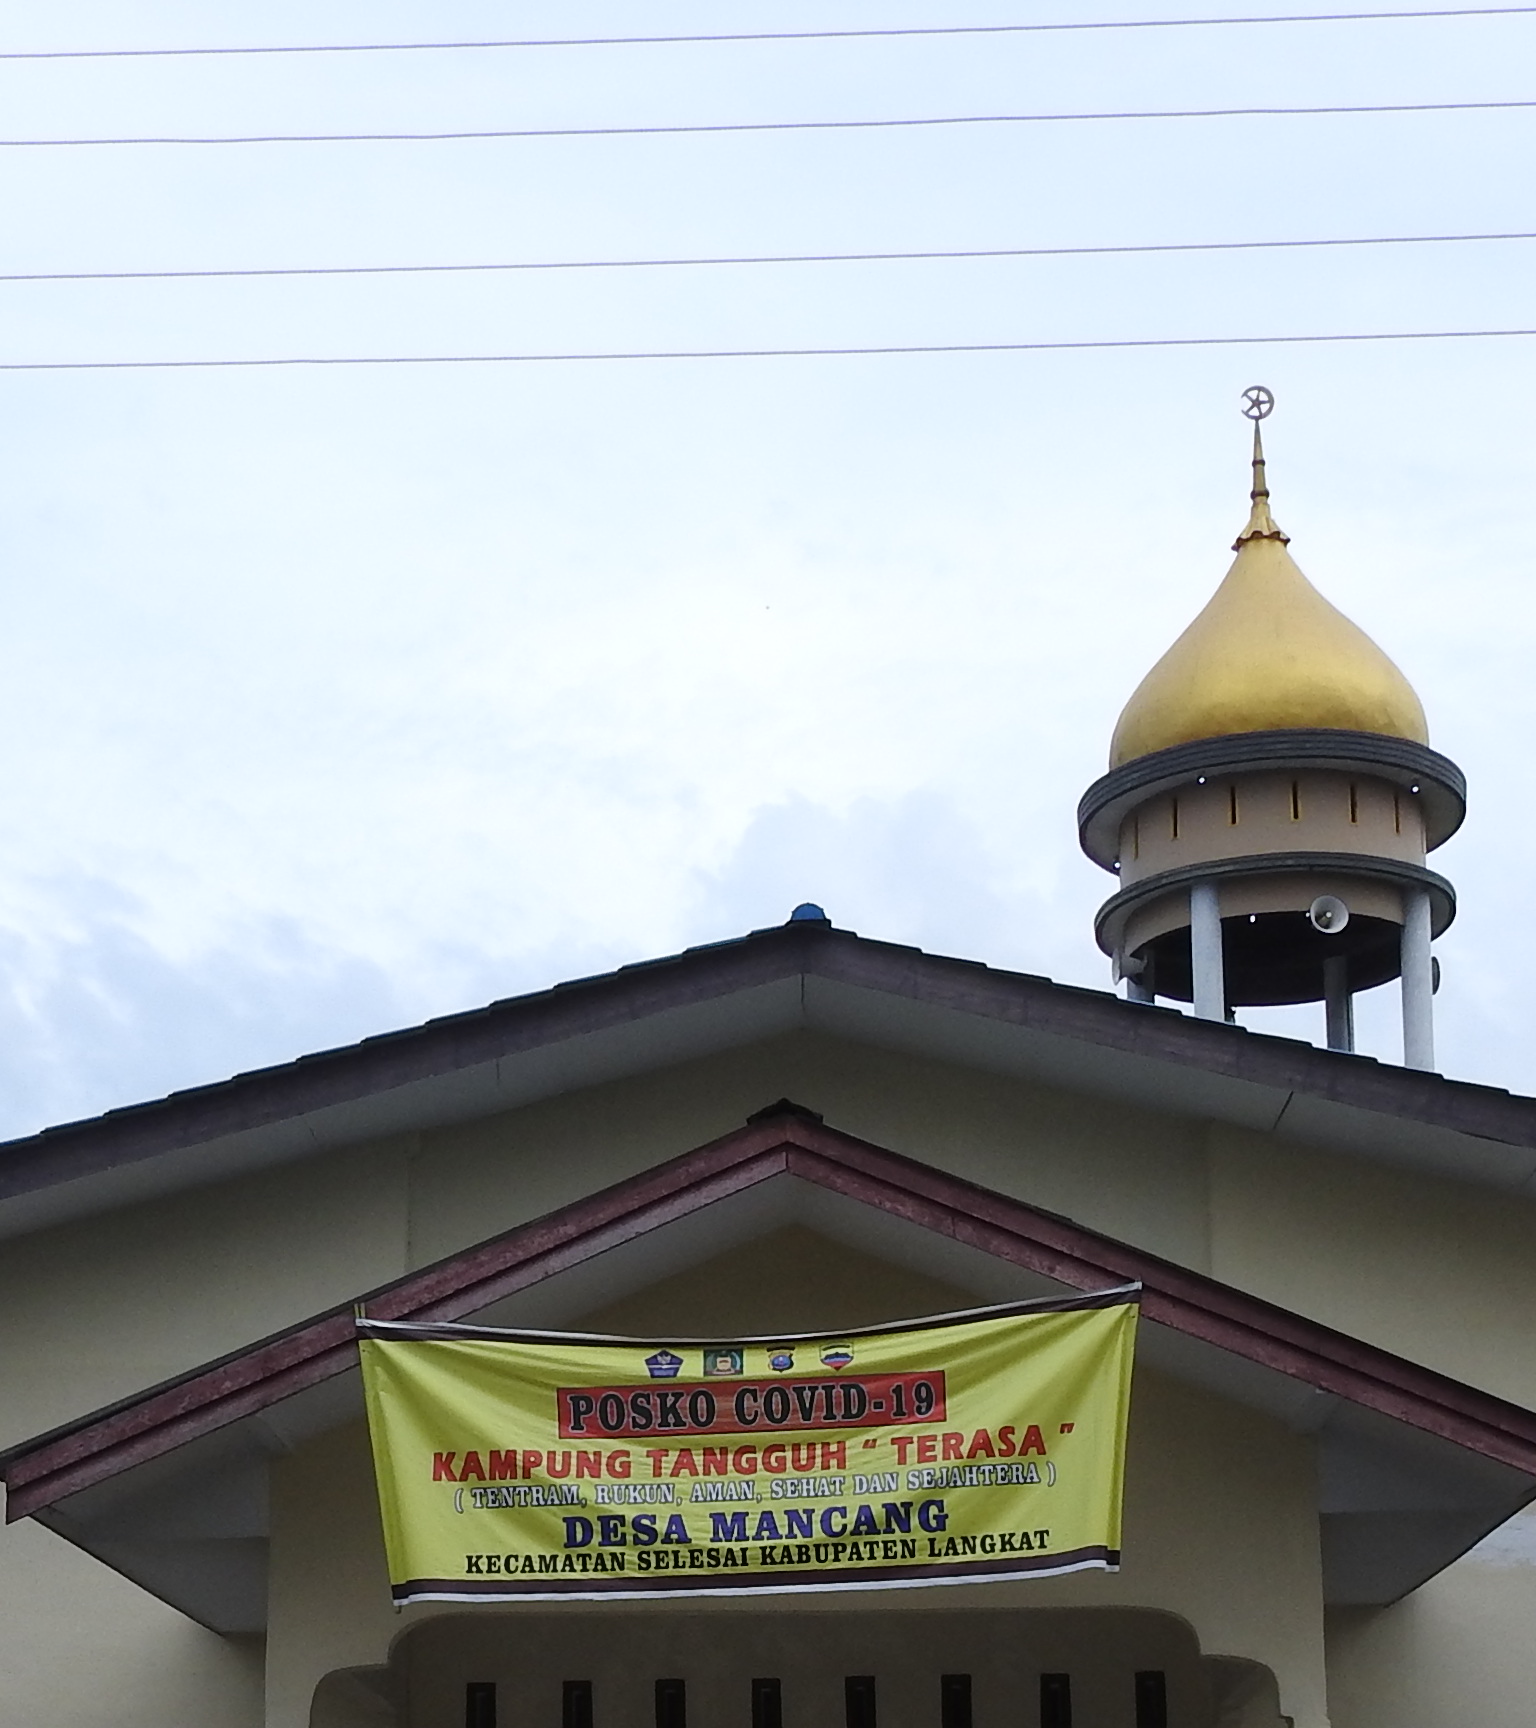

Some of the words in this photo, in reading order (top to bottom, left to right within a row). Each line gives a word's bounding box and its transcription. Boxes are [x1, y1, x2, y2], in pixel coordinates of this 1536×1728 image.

[567, 1389, 716, 1431] POSKO
[734, 1381, 935, 1427] COVID-19
[432, 1449, 632, 1482] KAMPUNG
[646, 1440, 847, 1478] TANGGUH
[890, 1424, 1048, 1466] TERASA
[471, 1484, 587, 1509] TENTRAM,
[594, 1482, 683, 1507] RUKUN,
[690, 1479, 762, 1504] AMAN,
[770, 1476, 846, 1500] SEHAT
[853, 1472, 899, 1496] DAN
[907, 1462, 1041, 1489] SEJAHTERA
[563, 1514, 692, 1549] DESA
[709, 1500, 949, 1543] MANCANG
[465, 1552, 626, 1574] KECAMATAN
[637, 1545, 750, 1571] SELESAI
[760, 1538, 917, 1567] KABUPATEN
[927, 1529, 1050, 1558] LANGKAT
